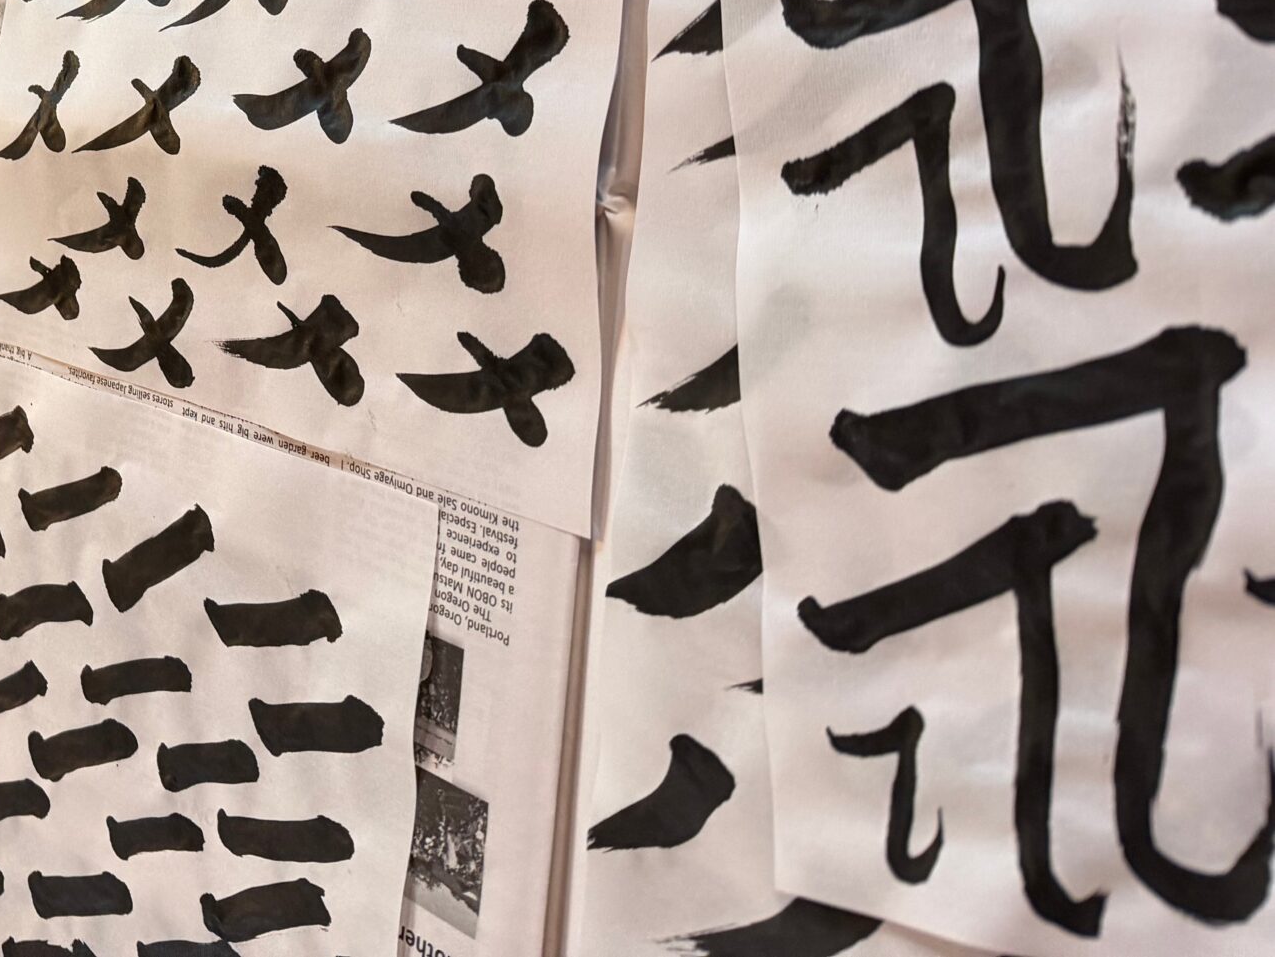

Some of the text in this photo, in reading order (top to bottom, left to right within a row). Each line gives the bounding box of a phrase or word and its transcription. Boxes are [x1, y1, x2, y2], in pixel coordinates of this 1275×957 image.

[16, 346, 26, 359] big
[67, 365, 174, 409] stores selling Japanese favorites.
[181, 406, 331, 467] beer garden were big hits and kept
[346, 460, 520, 533] the Kimono Sale and Omiyage Shop.
[446, 528, 517, 565] to experience
[480, 524, 519, 550] festival.
[439, 556, 460, 575] day,
[450, 546, 517, 580] people came
[460, 566, 506, 595] beautiful
[433, 572, 514, 615] its OBON Matsu
[434, 588, 492, 624] The Oregon
[465, 615, 510, 647] Portland,
